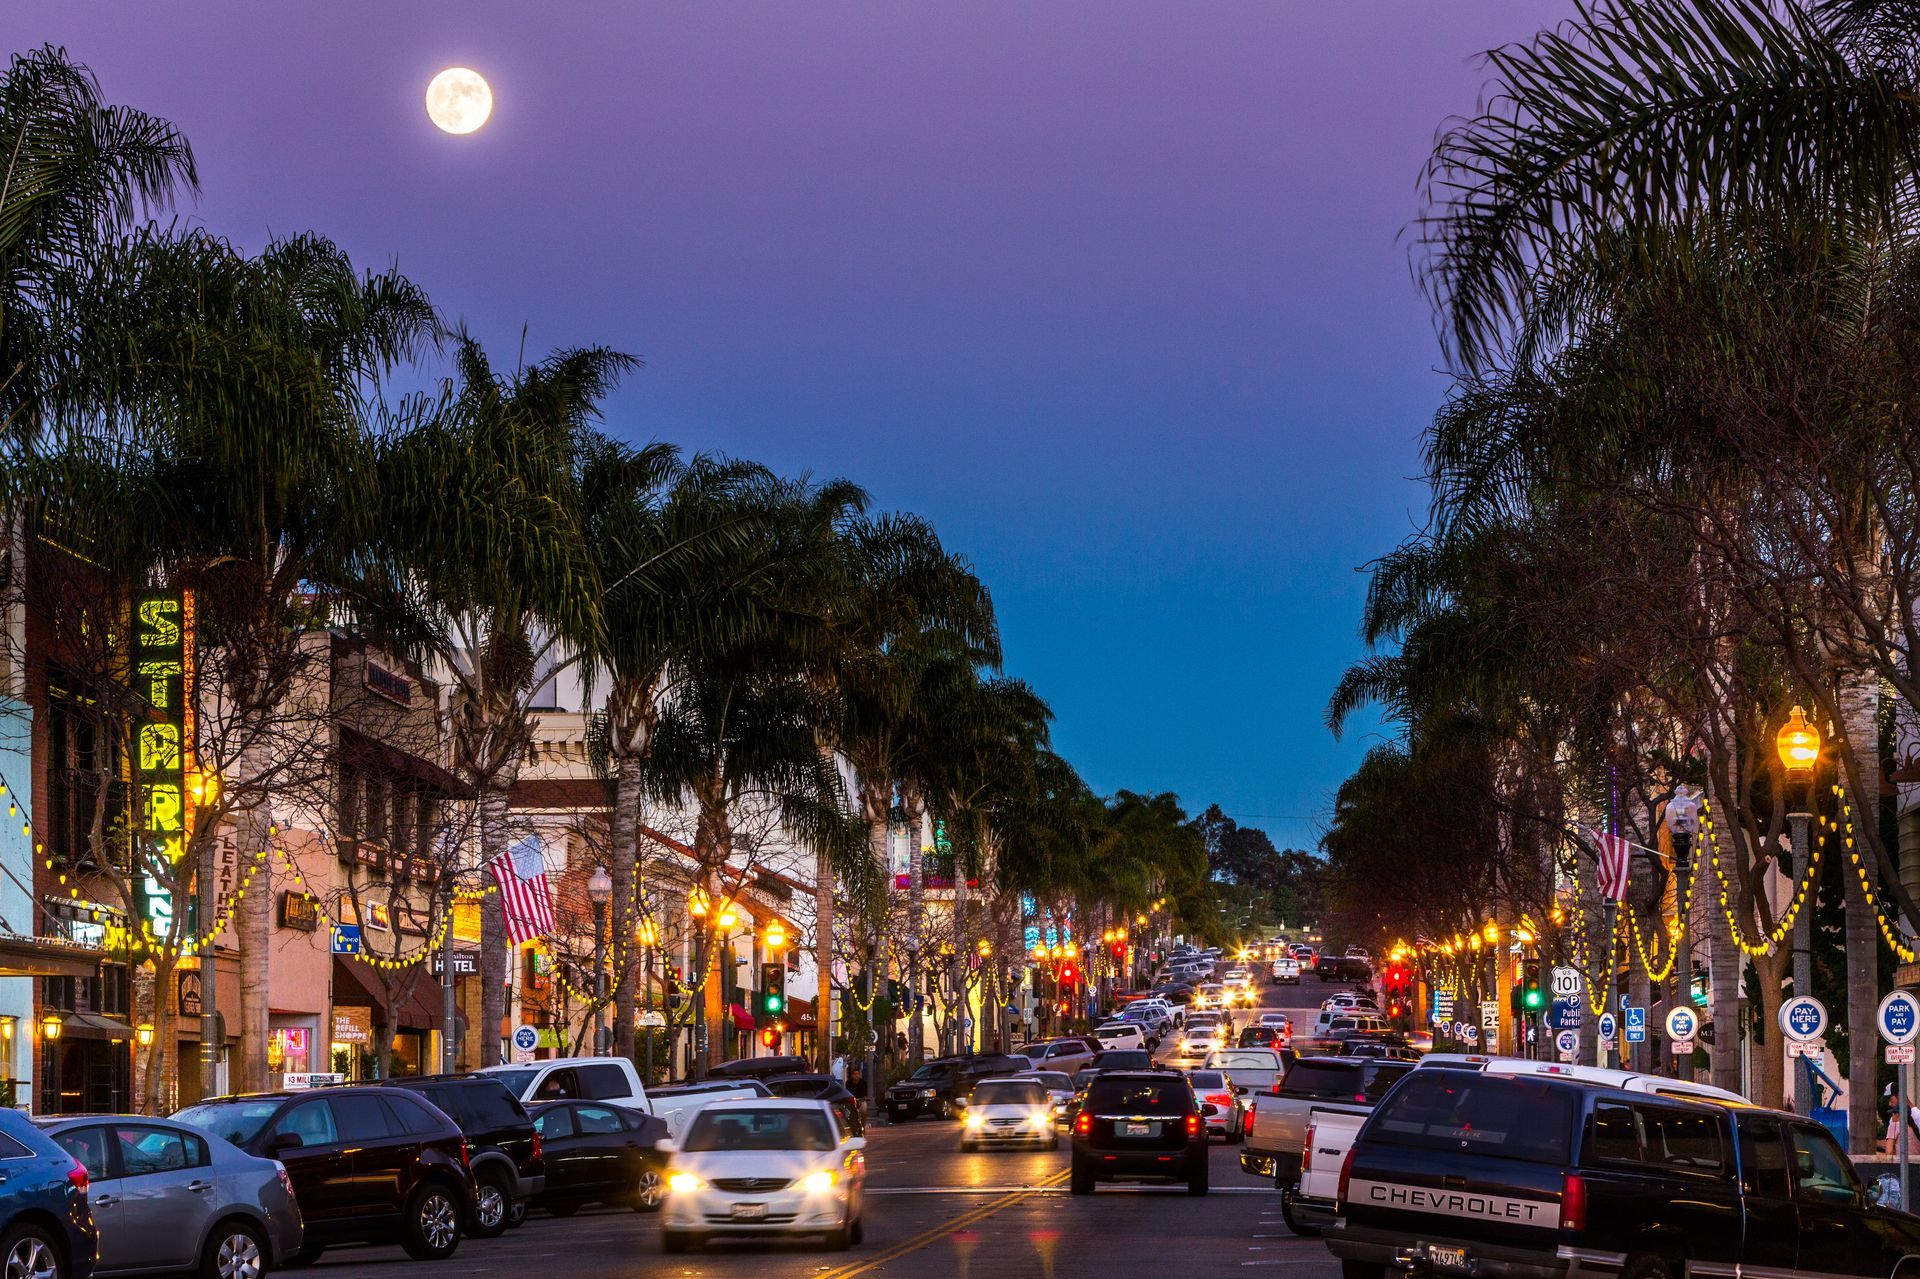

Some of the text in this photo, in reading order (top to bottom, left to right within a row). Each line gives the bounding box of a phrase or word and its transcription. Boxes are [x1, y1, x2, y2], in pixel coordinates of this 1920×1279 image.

[138, 600, 182, 831] STAR
[215, 837, 235, 933] LEATHER
[435, 960, 477, 972] HTEL
[1557, 976, 1578, 991] 101
[1562, 1008, 1580, 1018] Publi
[1484, 1016, 1499, 1027] 25
[1560, 1017, 1580, 1026] Parki
[1791, 1015, 1818, 1023] HERE
[334, 1032, 367, 1040] SHOPPE
[1371, 1186, 1539, 1219] CHEVROLET
